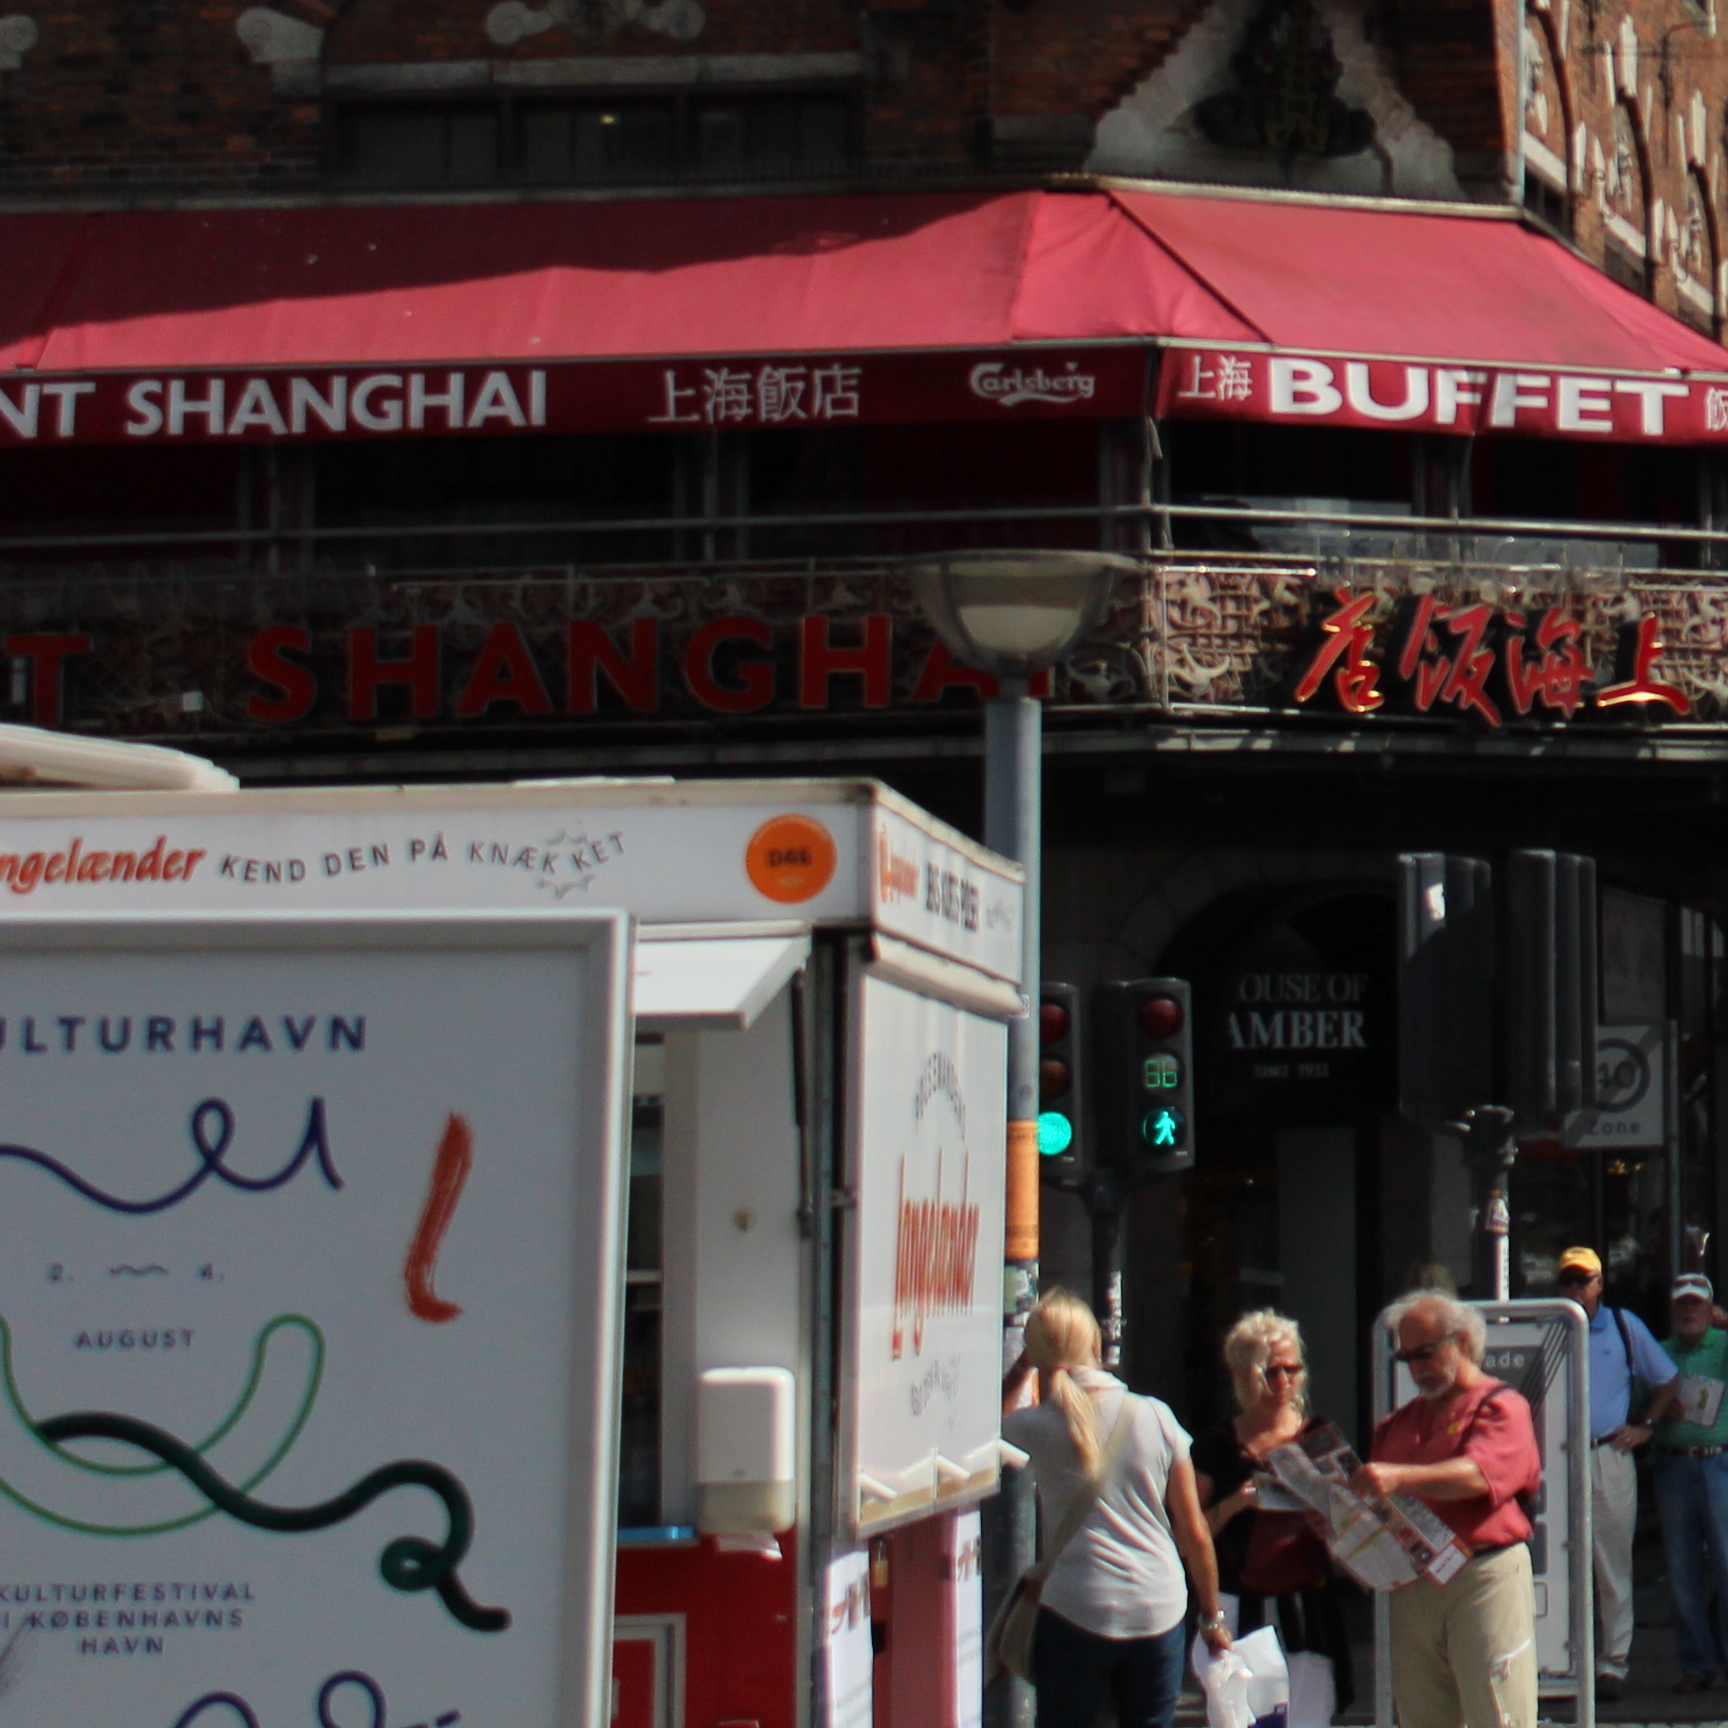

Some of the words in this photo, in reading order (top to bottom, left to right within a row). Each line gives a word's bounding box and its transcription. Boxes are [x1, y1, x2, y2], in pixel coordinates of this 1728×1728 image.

[125, 369, 547, 438] SHANGHAI
[647, 363, 863, 424] 上海飯店
[969, 361, 1096, 407] Carlsberg
[1177, 353, 1253, 405] 上海
[1267, 357, 1691, 435] BUFFET
[221, 853, 306, 883] KEND
[324, 842, 391, 876] DEN
[410, 830, 448, 862] PÅ
[1227, 1009, 1369, 1050] AMBER
[75, 1328, 196, 1350] AUGUST
[29, 1608, 244, 1630] KØBENHAVNS
[80, 1635, 164, 1655] HAVN
